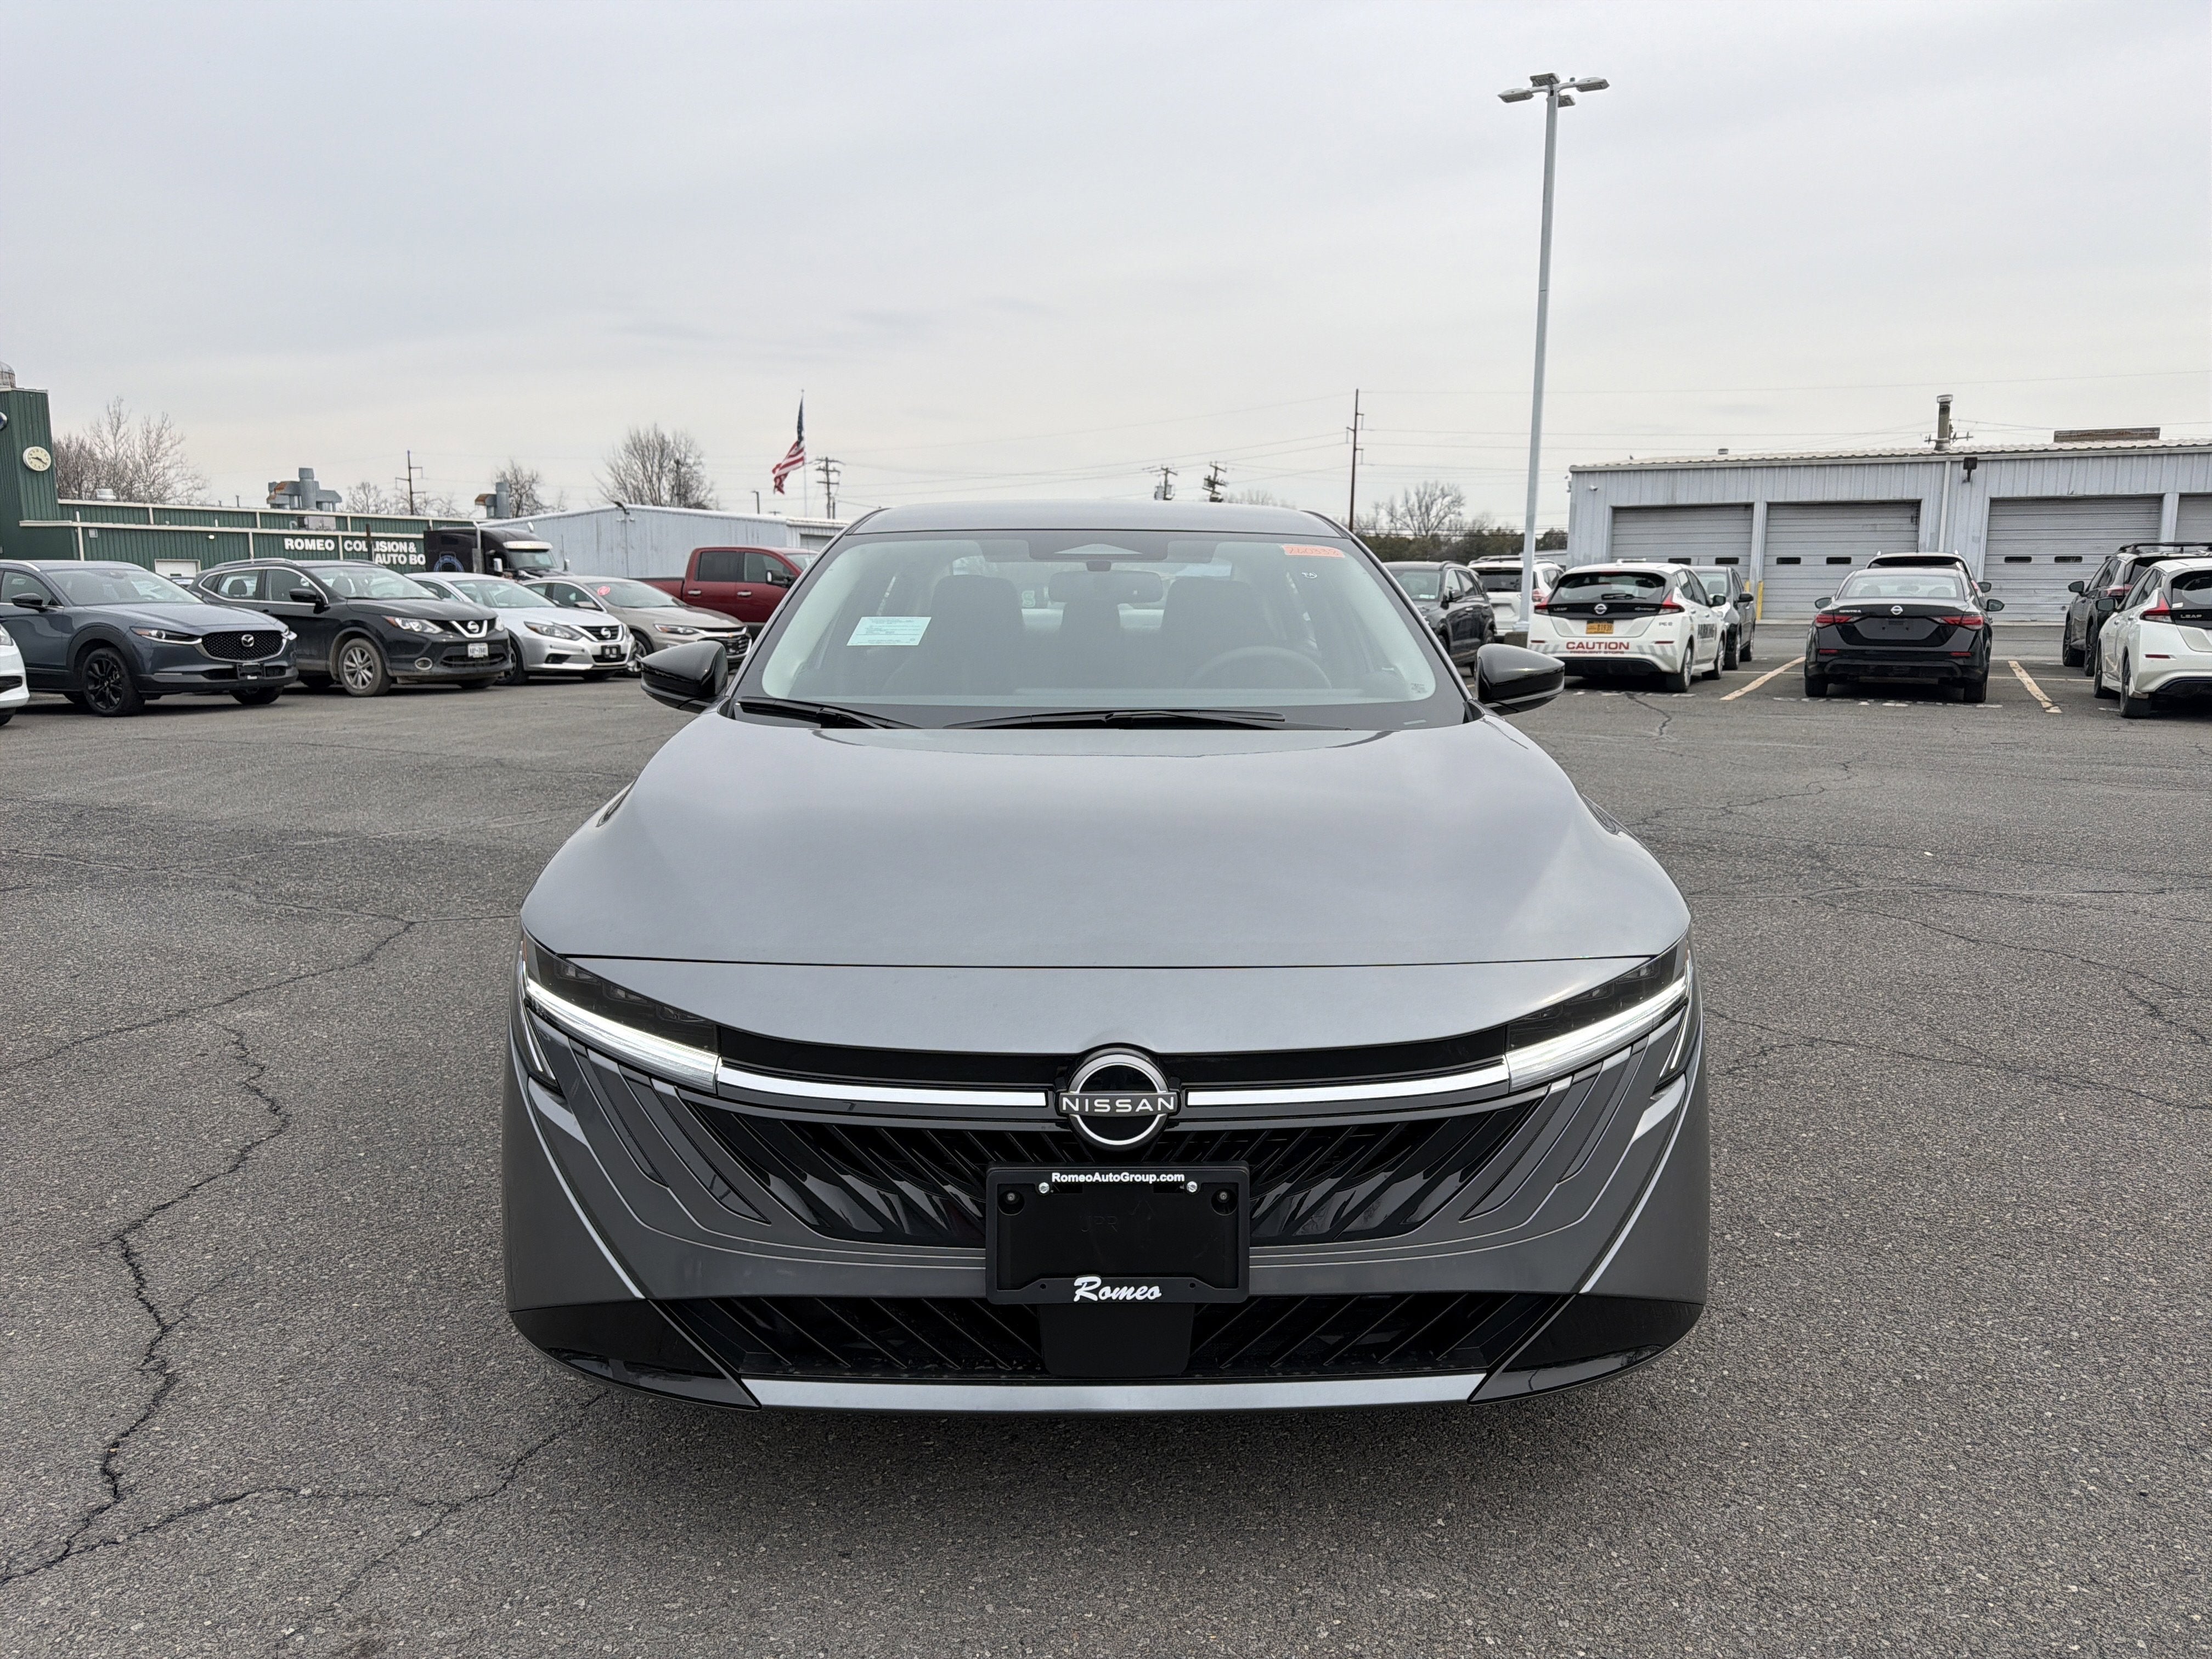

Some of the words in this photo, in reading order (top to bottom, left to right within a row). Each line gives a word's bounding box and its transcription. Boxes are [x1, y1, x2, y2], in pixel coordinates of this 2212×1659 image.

[284, 538, 335, 551] ROMEO
[344, 540, 408, 553] COLISION
[408, 541, 416, 553] &
[375, 553, 407, 565] AUTO
[1566, 641, 1629, 650] CAUTION
[1062, 1096, 1175, 1113] NISSAN
[1052, 1172, 1185, 1184] RomeoAutoGroup.com
[1074, 1276, 1162, 1302] Romeo
